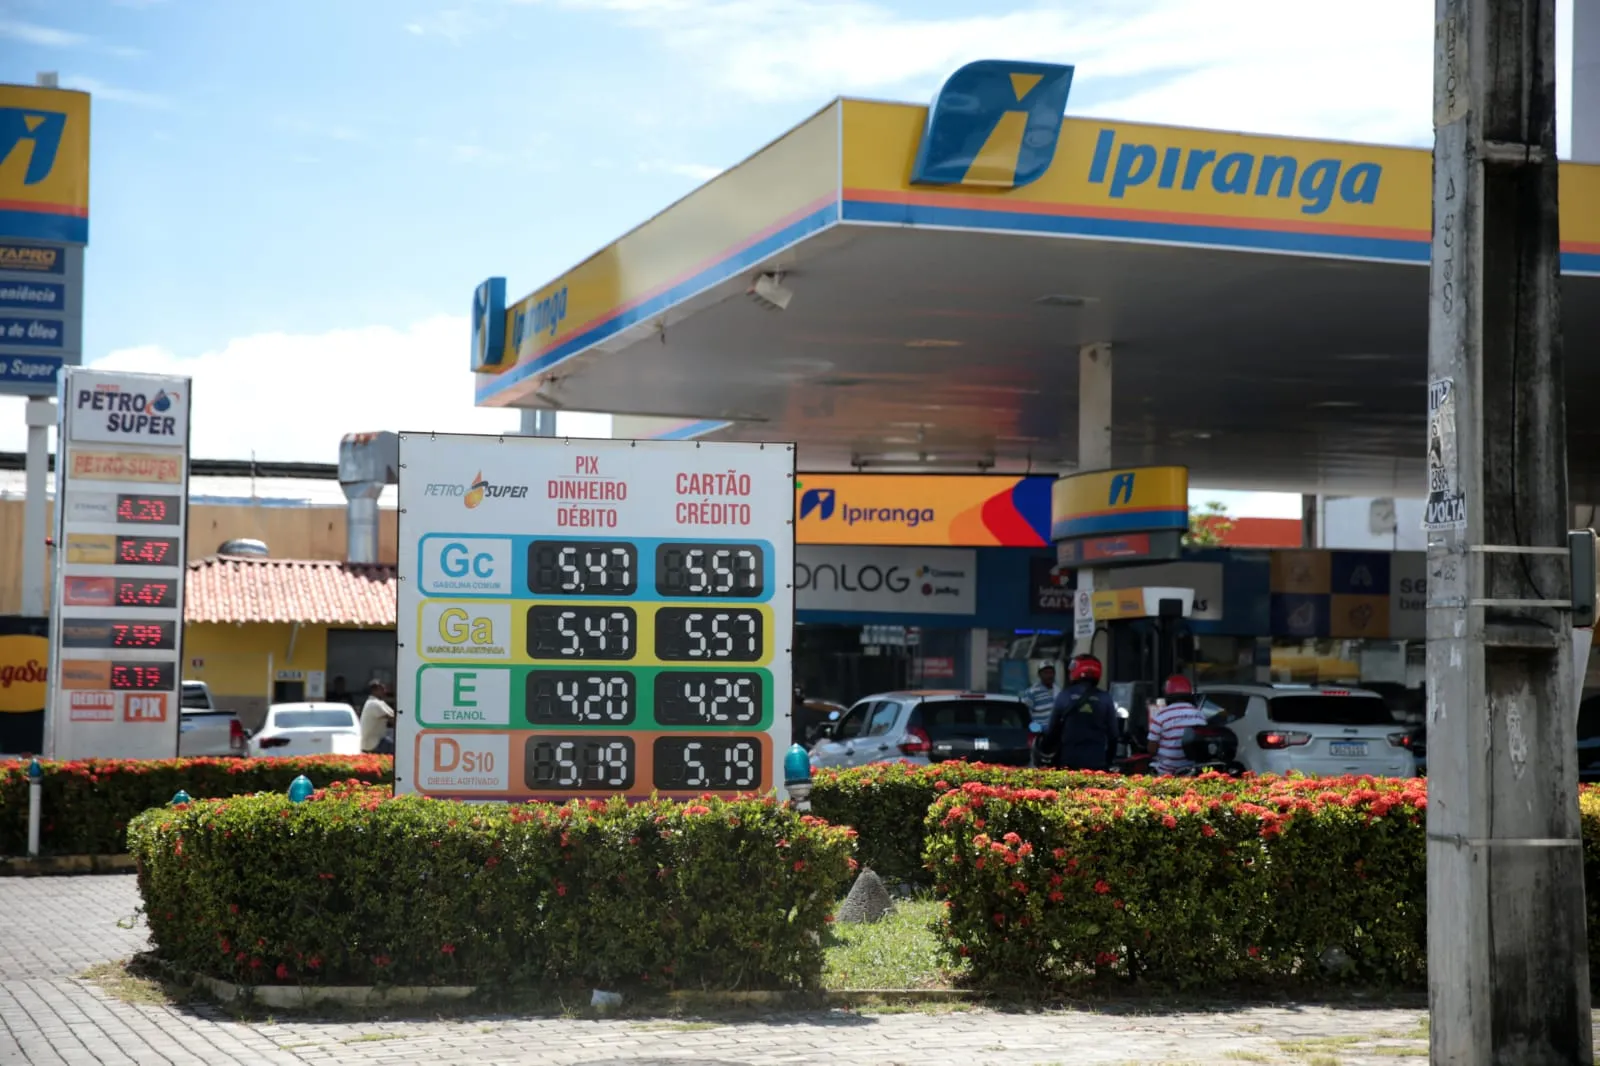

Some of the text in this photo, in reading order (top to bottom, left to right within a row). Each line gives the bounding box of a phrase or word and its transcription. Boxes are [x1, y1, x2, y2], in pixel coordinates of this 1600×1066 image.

[1087, 128, 1383, 215] Ipiranga
[11, 358, 54, 378] Super
[78, 389, 147, 412] PETRO
[107, 413, 176, 436] SUPER
[575, 455, 599, 475] PIX
[424, 483, 529, 499] PETRO SUPER
[547, 479, 627, 501] DINHEIRO
[675, 470, 751, 496] CARTÃO
[557, 504, 618, 528] DÉBITO
[675, 498, 751, 525] CRÉDITO
[842, 503, 934, 528] Ipiranga
[1428, 499, 1466, 524] VOLTA
[439, 542, 494, 578] Gc
[558, 547, 629, 591] 5,47
[685, 549, 756, 594] 5,57
[438, 607, 494, 645] Ga
[558, 611, 629, 656] 5,47
[685, 614, 755, 658] 5,57
[453, 672, 477, 707] E
[556, 677, 628, 722] 4,20
[684, 678, 754, 722] 4,25
[128, 697, 162, 718] PIX
[443, 710, 486, 720] ETANOL
[555, 742, 627, 787] 5,19
[683, 743, 754, 787] 5,19
[427, 776, 456, 785] DIESEL
